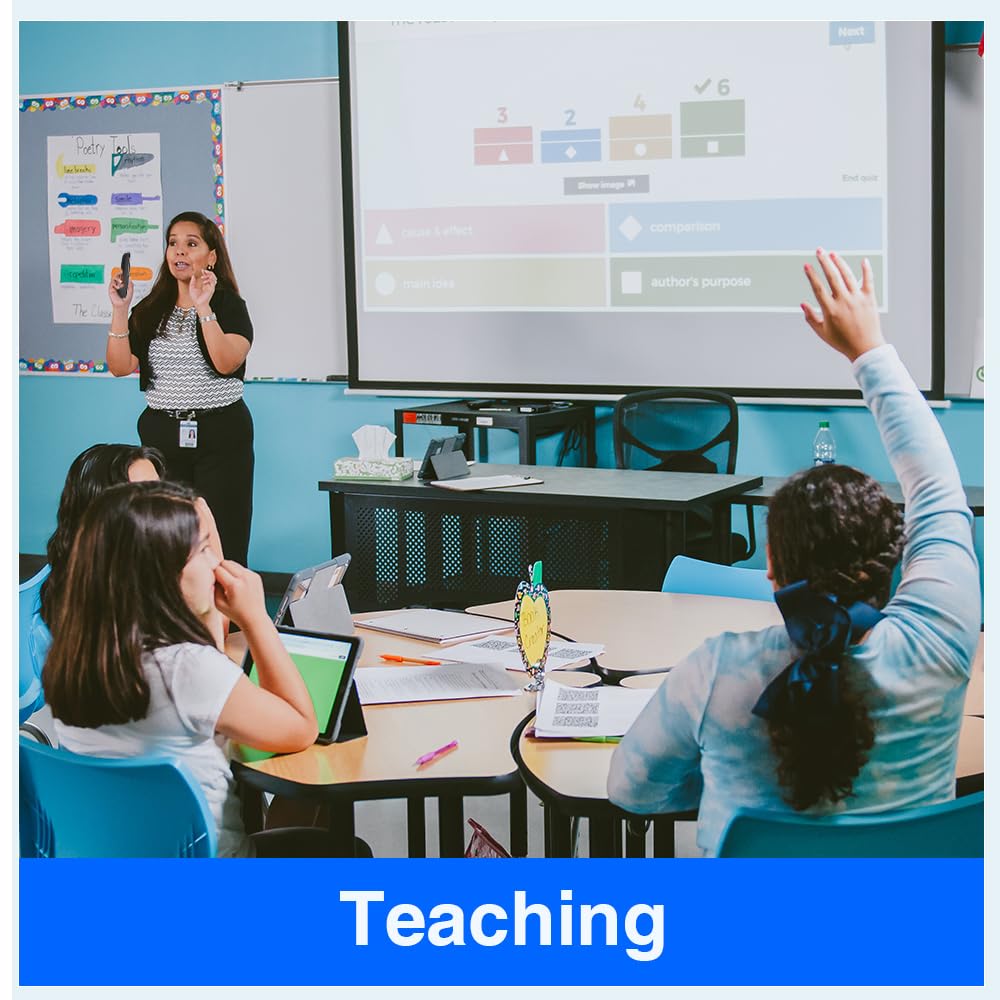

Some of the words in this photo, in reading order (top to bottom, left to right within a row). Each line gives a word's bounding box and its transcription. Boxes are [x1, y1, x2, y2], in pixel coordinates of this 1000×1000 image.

[717, 78, 731, 95] 6
[633, 94, 647, 111] 4
[497, 106, 509, 123] 3
[564, 110, 577, 126] 2
[76, 136, 106, 158] Poetry
[649, 221, 721, 234] comparison
[650, 275, 699, 288] author's
[701, 275, 751, 290] purpose
